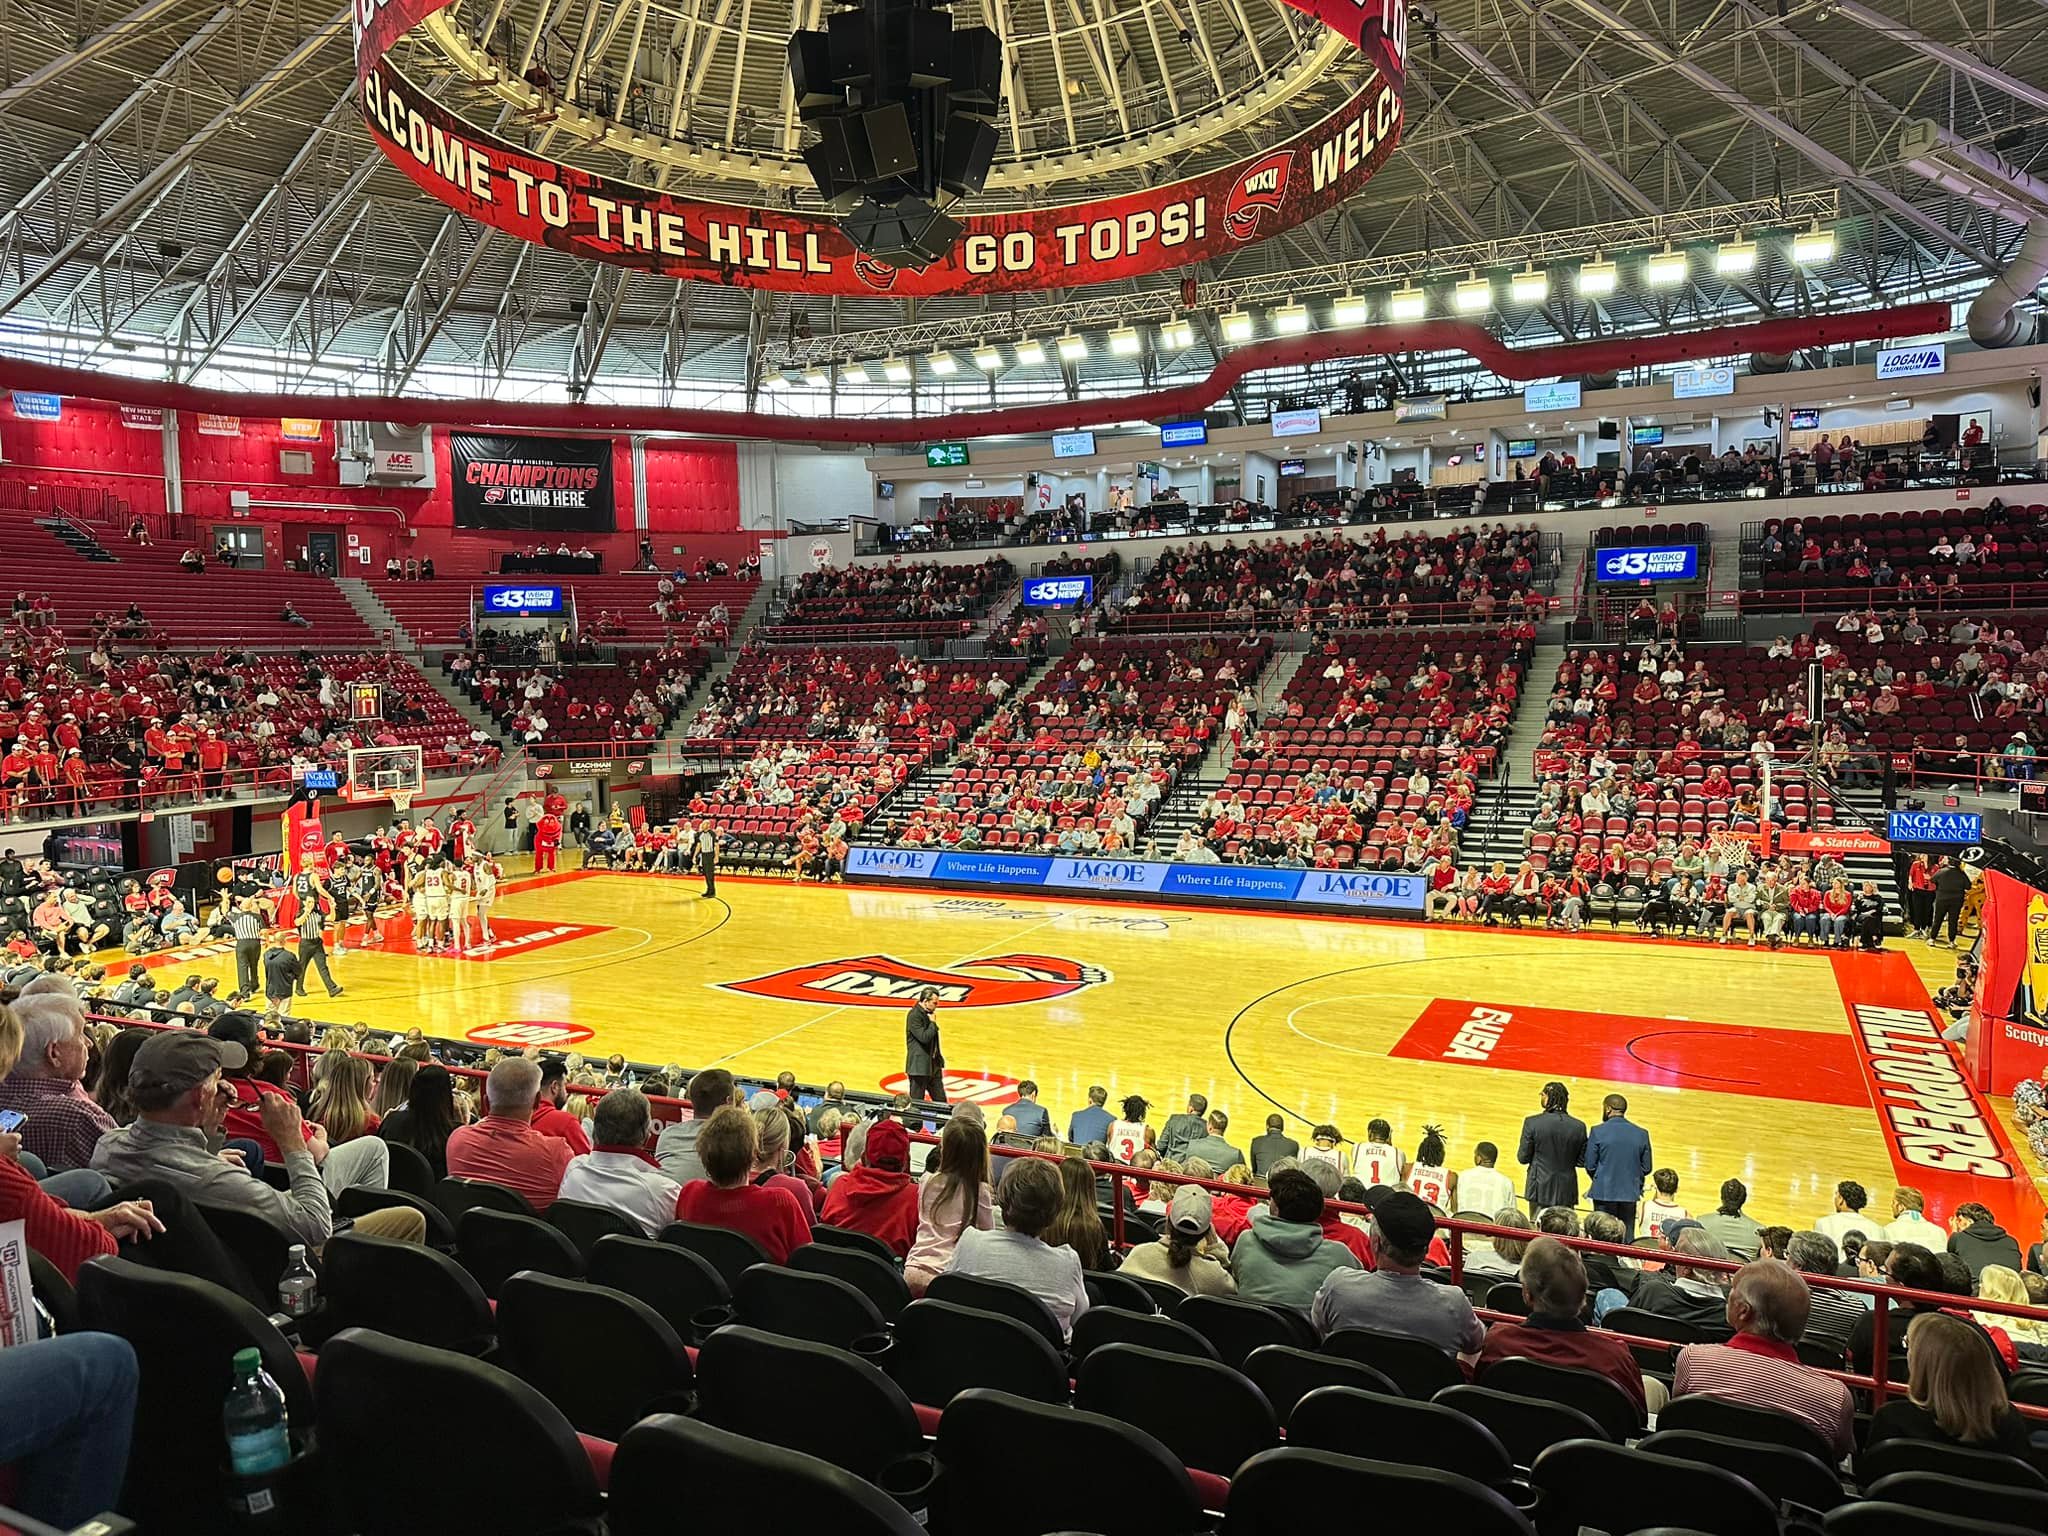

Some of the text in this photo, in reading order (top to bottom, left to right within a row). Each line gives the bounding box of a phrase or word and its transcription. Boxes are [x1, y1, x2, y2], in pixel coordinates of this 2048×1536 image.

[365, 66, 832, 273] ELCOME TO THE HILL
[1243, 168, 1279, 195] WKU
[965, 198, 1206, 274] GO TOPS!
[1880, 364, 1921, 373] ALUMINUM
[1884, 352, 1927, 367] LOGAN
[121, 406, 136, 414] NEW
[387, 453, 413, 464] ACE
[465, 462, 599, 489] CHAMPIONS
[510, 488, 586, 507] CLIMB HERE
[1620, 553, 1648, 575] 13
[1647, 562, 1684, 573] NEWS
[502, 590, 525, 607] 13
[1040, 582, 1058, 600] 13
[524, 598, 552, 606] NEWS
[570, 761, 612, 769] LEACHMAN
[305, 772, 336, 781] INGRAM
[1892, 814, 1977, 829] INGRAM
[1894, 828, 1977, 841] INSURANCE
[857, 850, 924, 869] JAGOE
[948, 861, 1040, 877] Where Life Happens.
[1067, 861, 1145, 882] JAGOE
[297, 881, 308, 893] 23
[427, 877, 439, 886] 23
[1177, 873, 1287, 891] Where Life Happens.
[1318, 873, 1412, 898] JAGOE
[1347, 889, 1384, 898] HOMES
[801, 970, 975, 1003] WKU
[1442, 1006, 1513, 1061] CUSA
[1851, 1003, 2016, 1180] HILLTOPPERS
[1120, 1138, 1134, 1161] 3
[1366, 1147, 1387, 1157] KEITA
[1371, 1160, 1380, 1184] 1
[1413, 1180, 1440, 1205] 13
[8, 1269, 19, 1312] HOUCHENS
